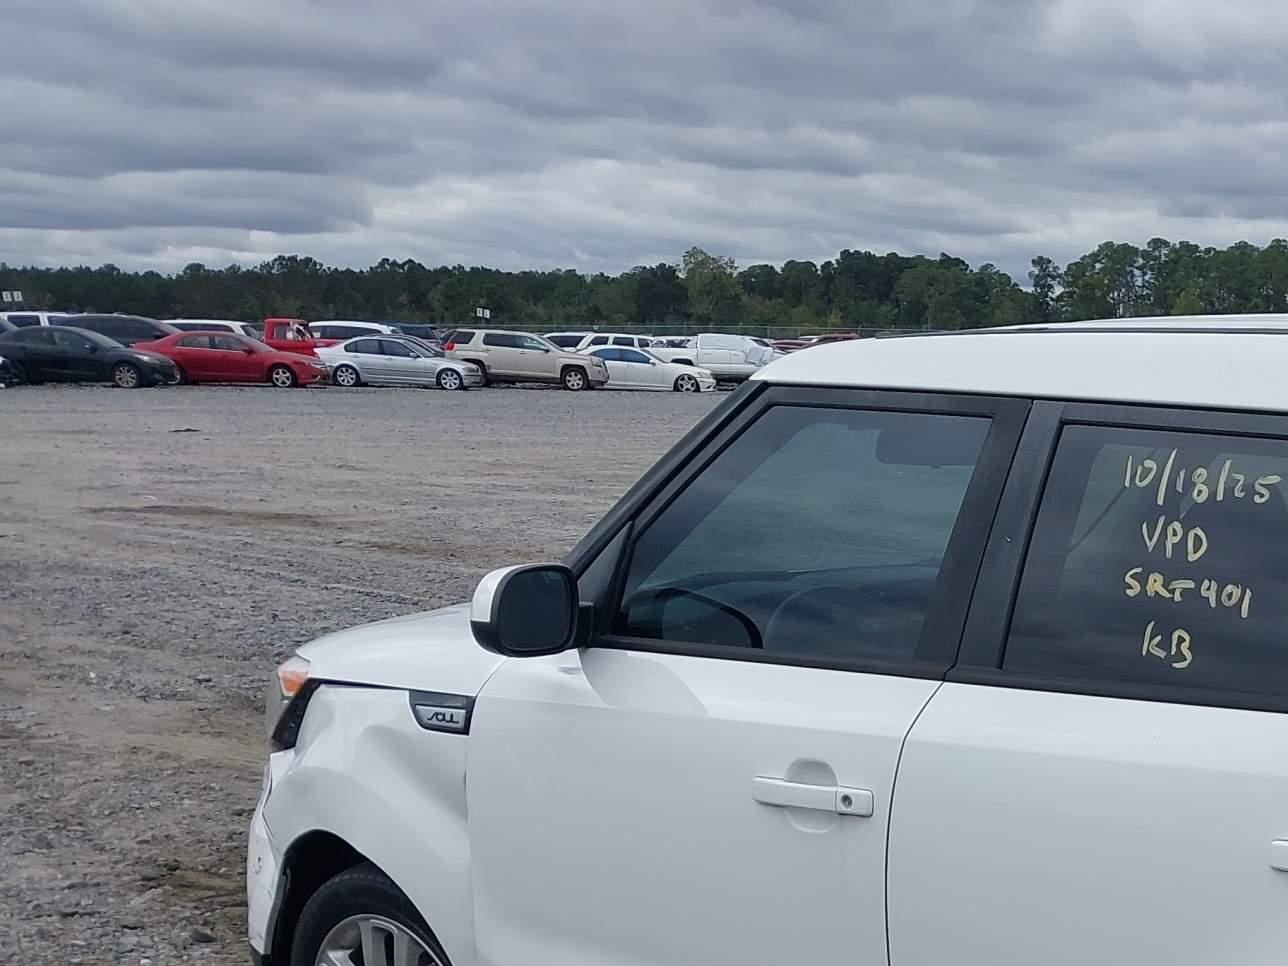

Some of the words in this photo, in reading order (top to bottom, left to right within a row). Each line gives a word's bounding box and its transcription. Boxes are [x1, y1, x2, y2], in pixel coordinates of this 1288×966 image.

[1124, 448, 1282, 504] 10/18/25
[1142, 515, 1208, 562] VPD
[1142, 620, 1193, 669] KB
